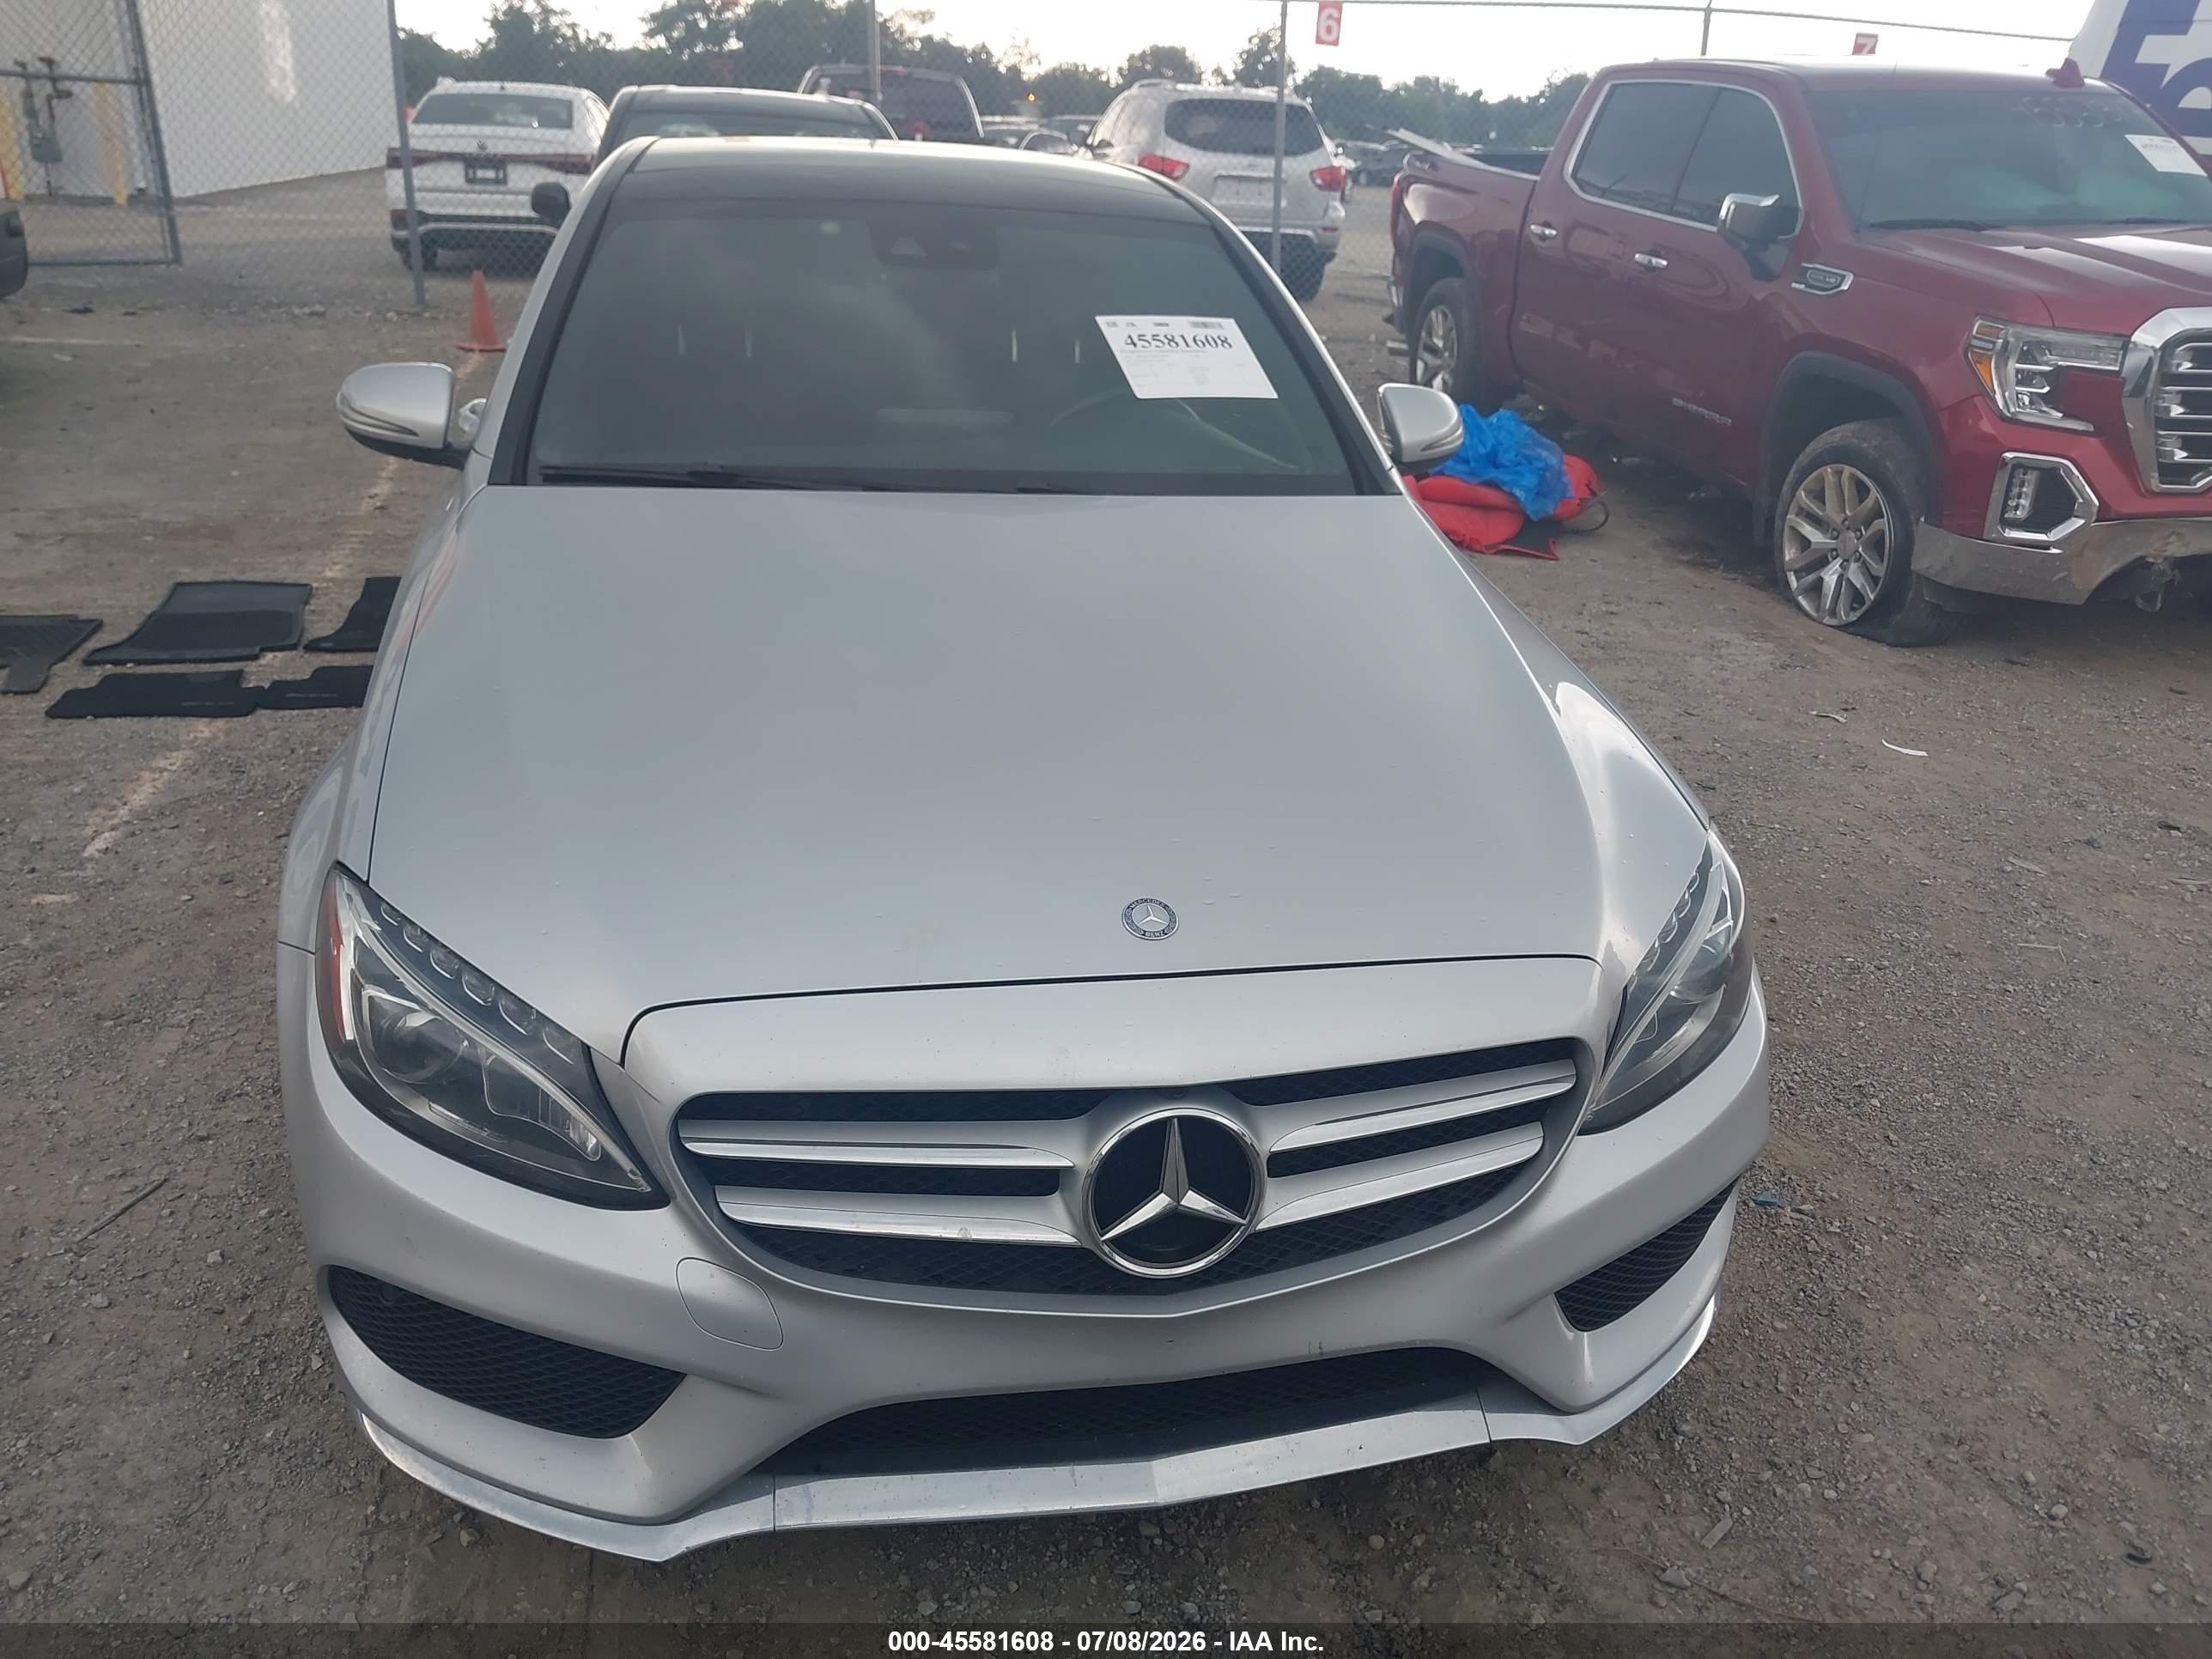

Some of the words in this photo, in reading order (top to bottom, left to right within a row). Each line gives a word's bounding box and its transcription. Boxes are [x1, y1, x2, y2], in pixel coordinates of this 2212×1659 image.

[1317, 7, 1340, 42] 6
[1856, 36, 1878, 55] 7
[1124, 333, 1233, 349] 45581608
